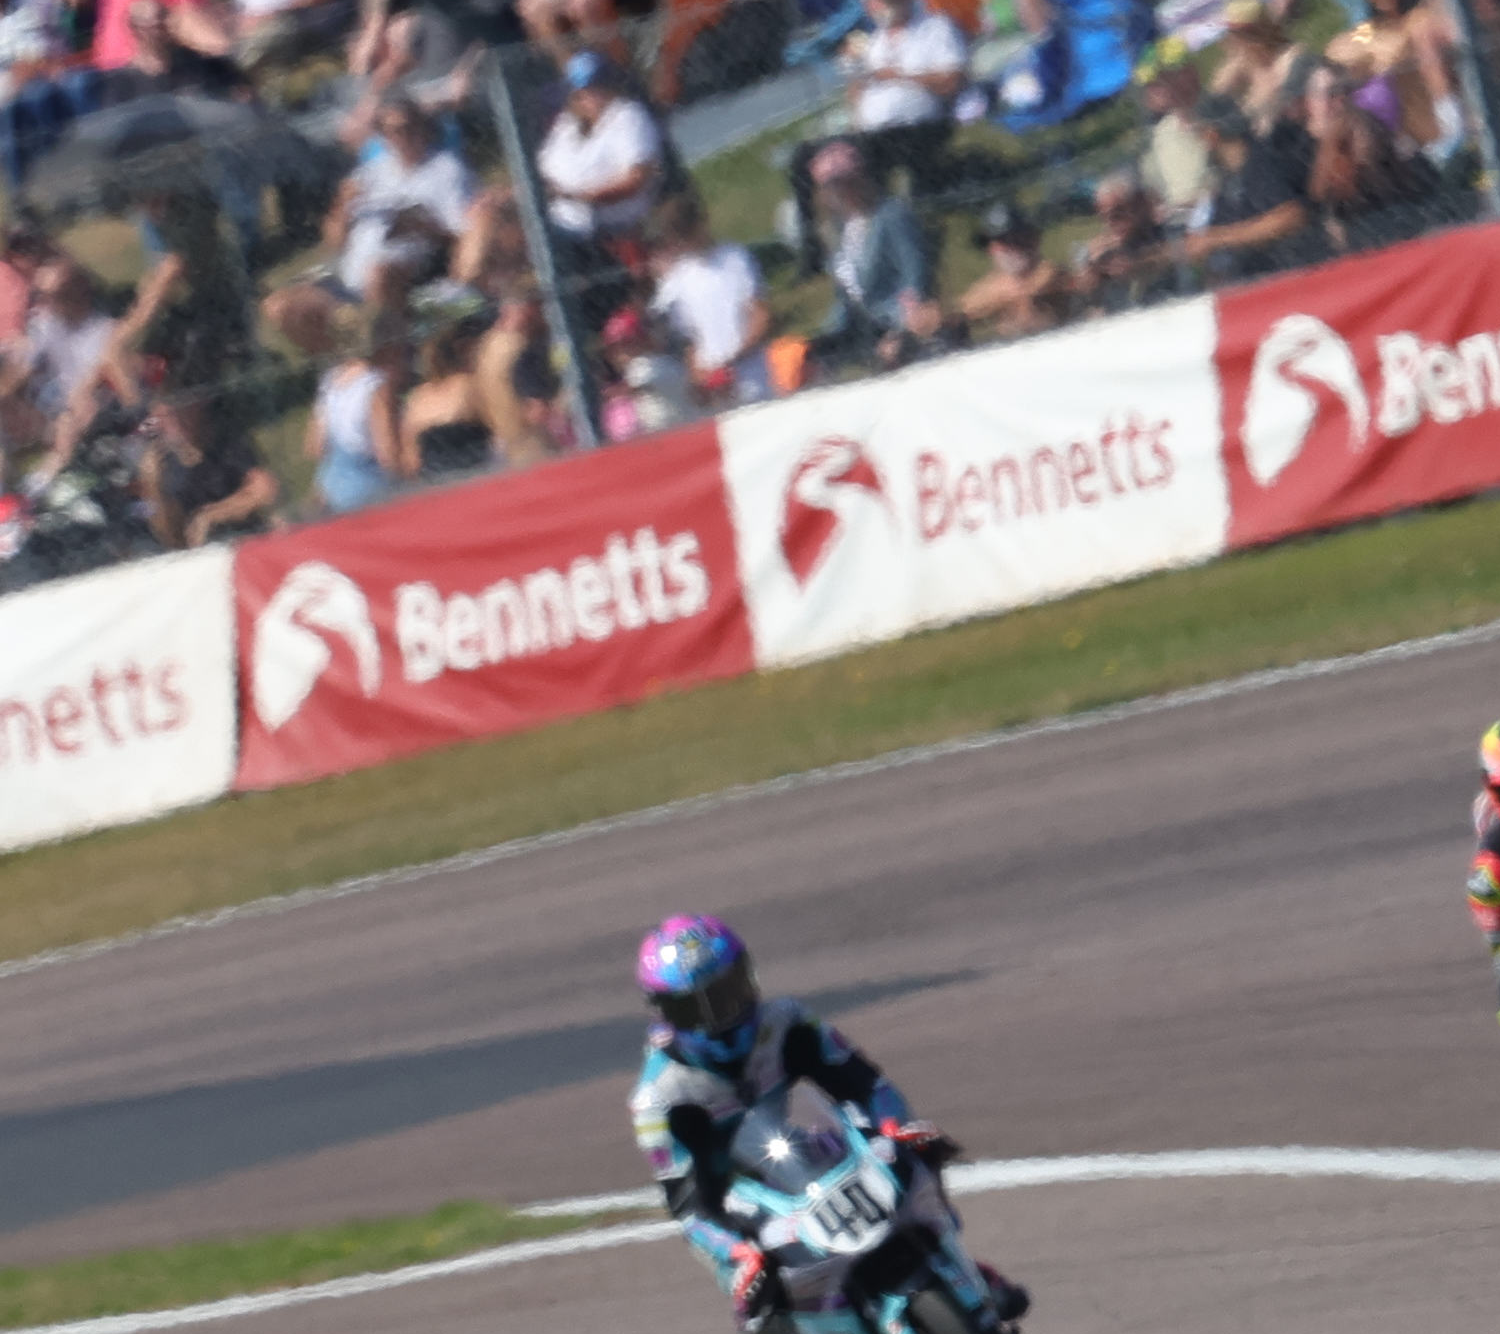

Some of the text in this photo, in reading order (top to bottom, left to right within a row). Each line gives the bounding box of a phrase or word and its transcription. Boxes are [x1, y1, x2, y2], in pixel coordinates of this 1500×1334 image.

[914, 409, 1180, 546] Bennetts
[395, 524, 712, 684] Bennetts
[0, 652, 195, 767] netts
